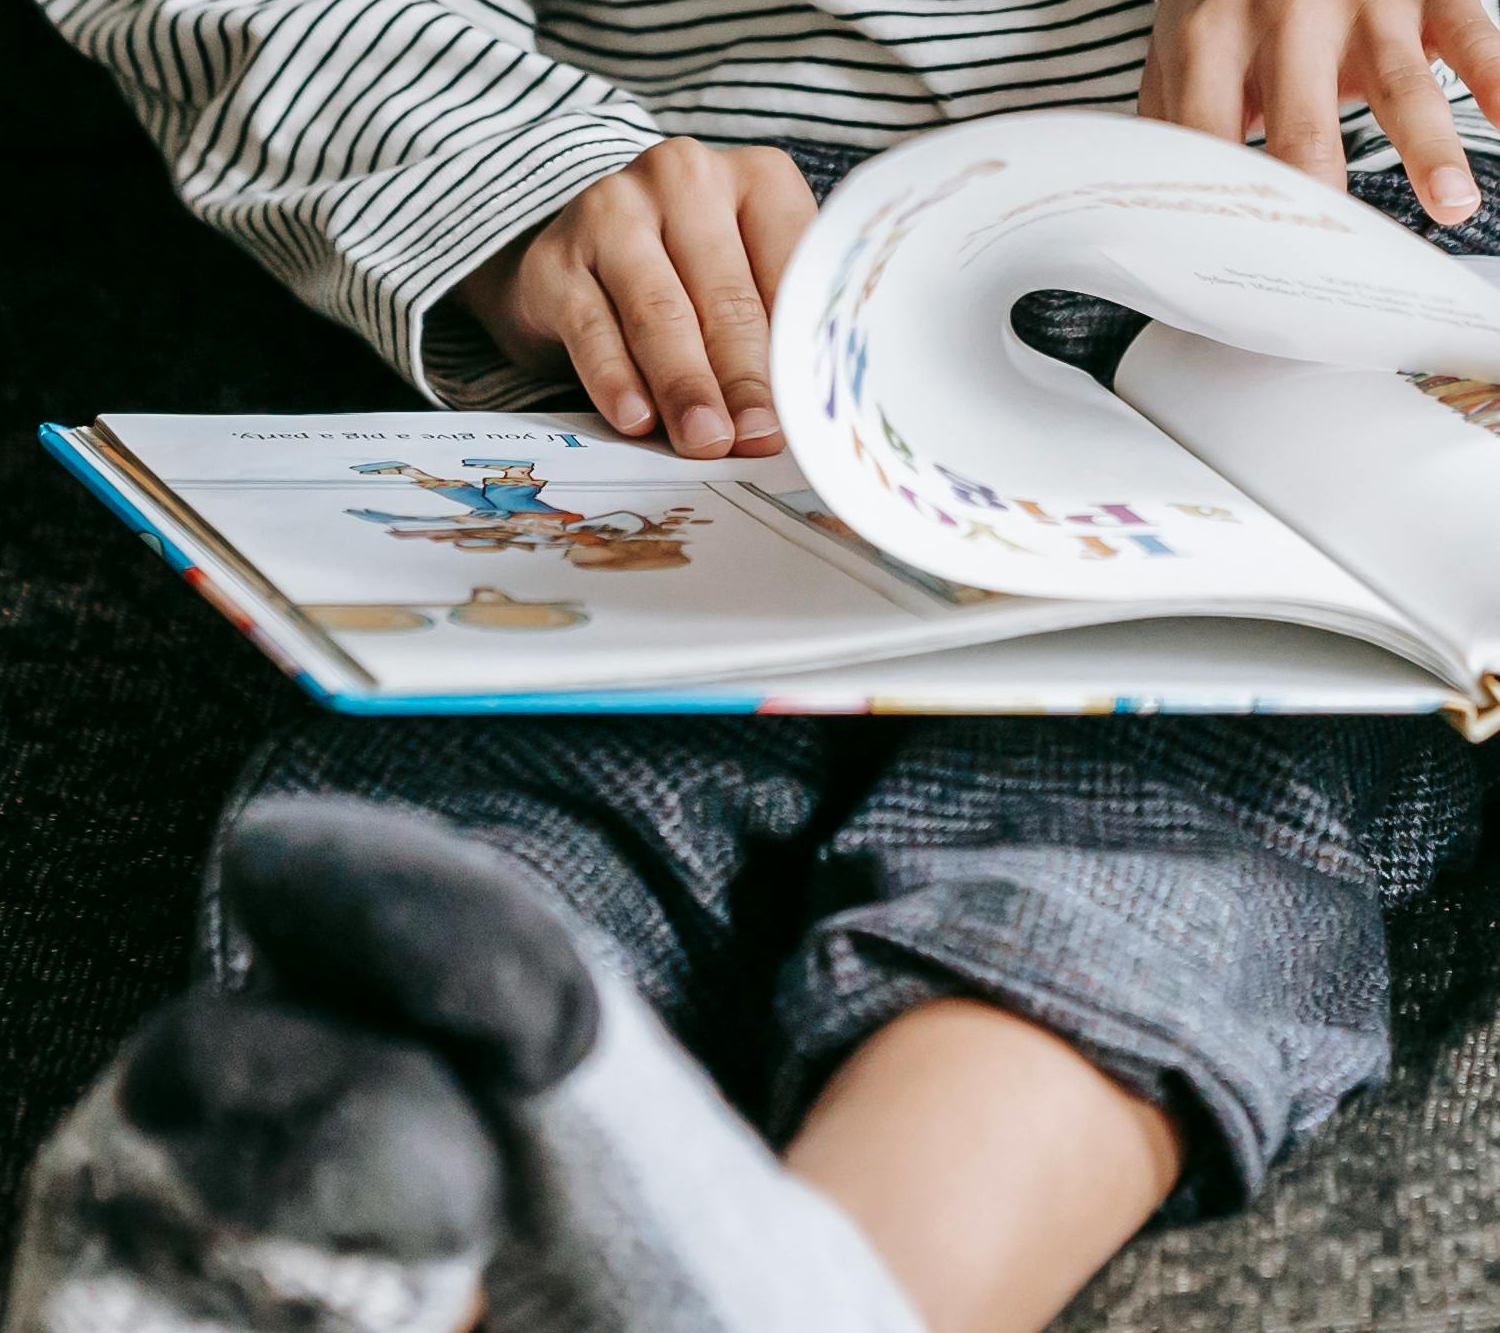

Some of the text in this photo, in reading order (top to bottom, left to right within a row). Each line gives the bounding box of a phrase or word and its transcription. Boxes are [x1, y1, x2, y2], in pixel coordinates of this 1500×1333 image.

[340, 432, 388, 442] pig
[420, 432, 476, 442] give
[485, 431, 537, 441] you
[546, 432, 590, 448] If
